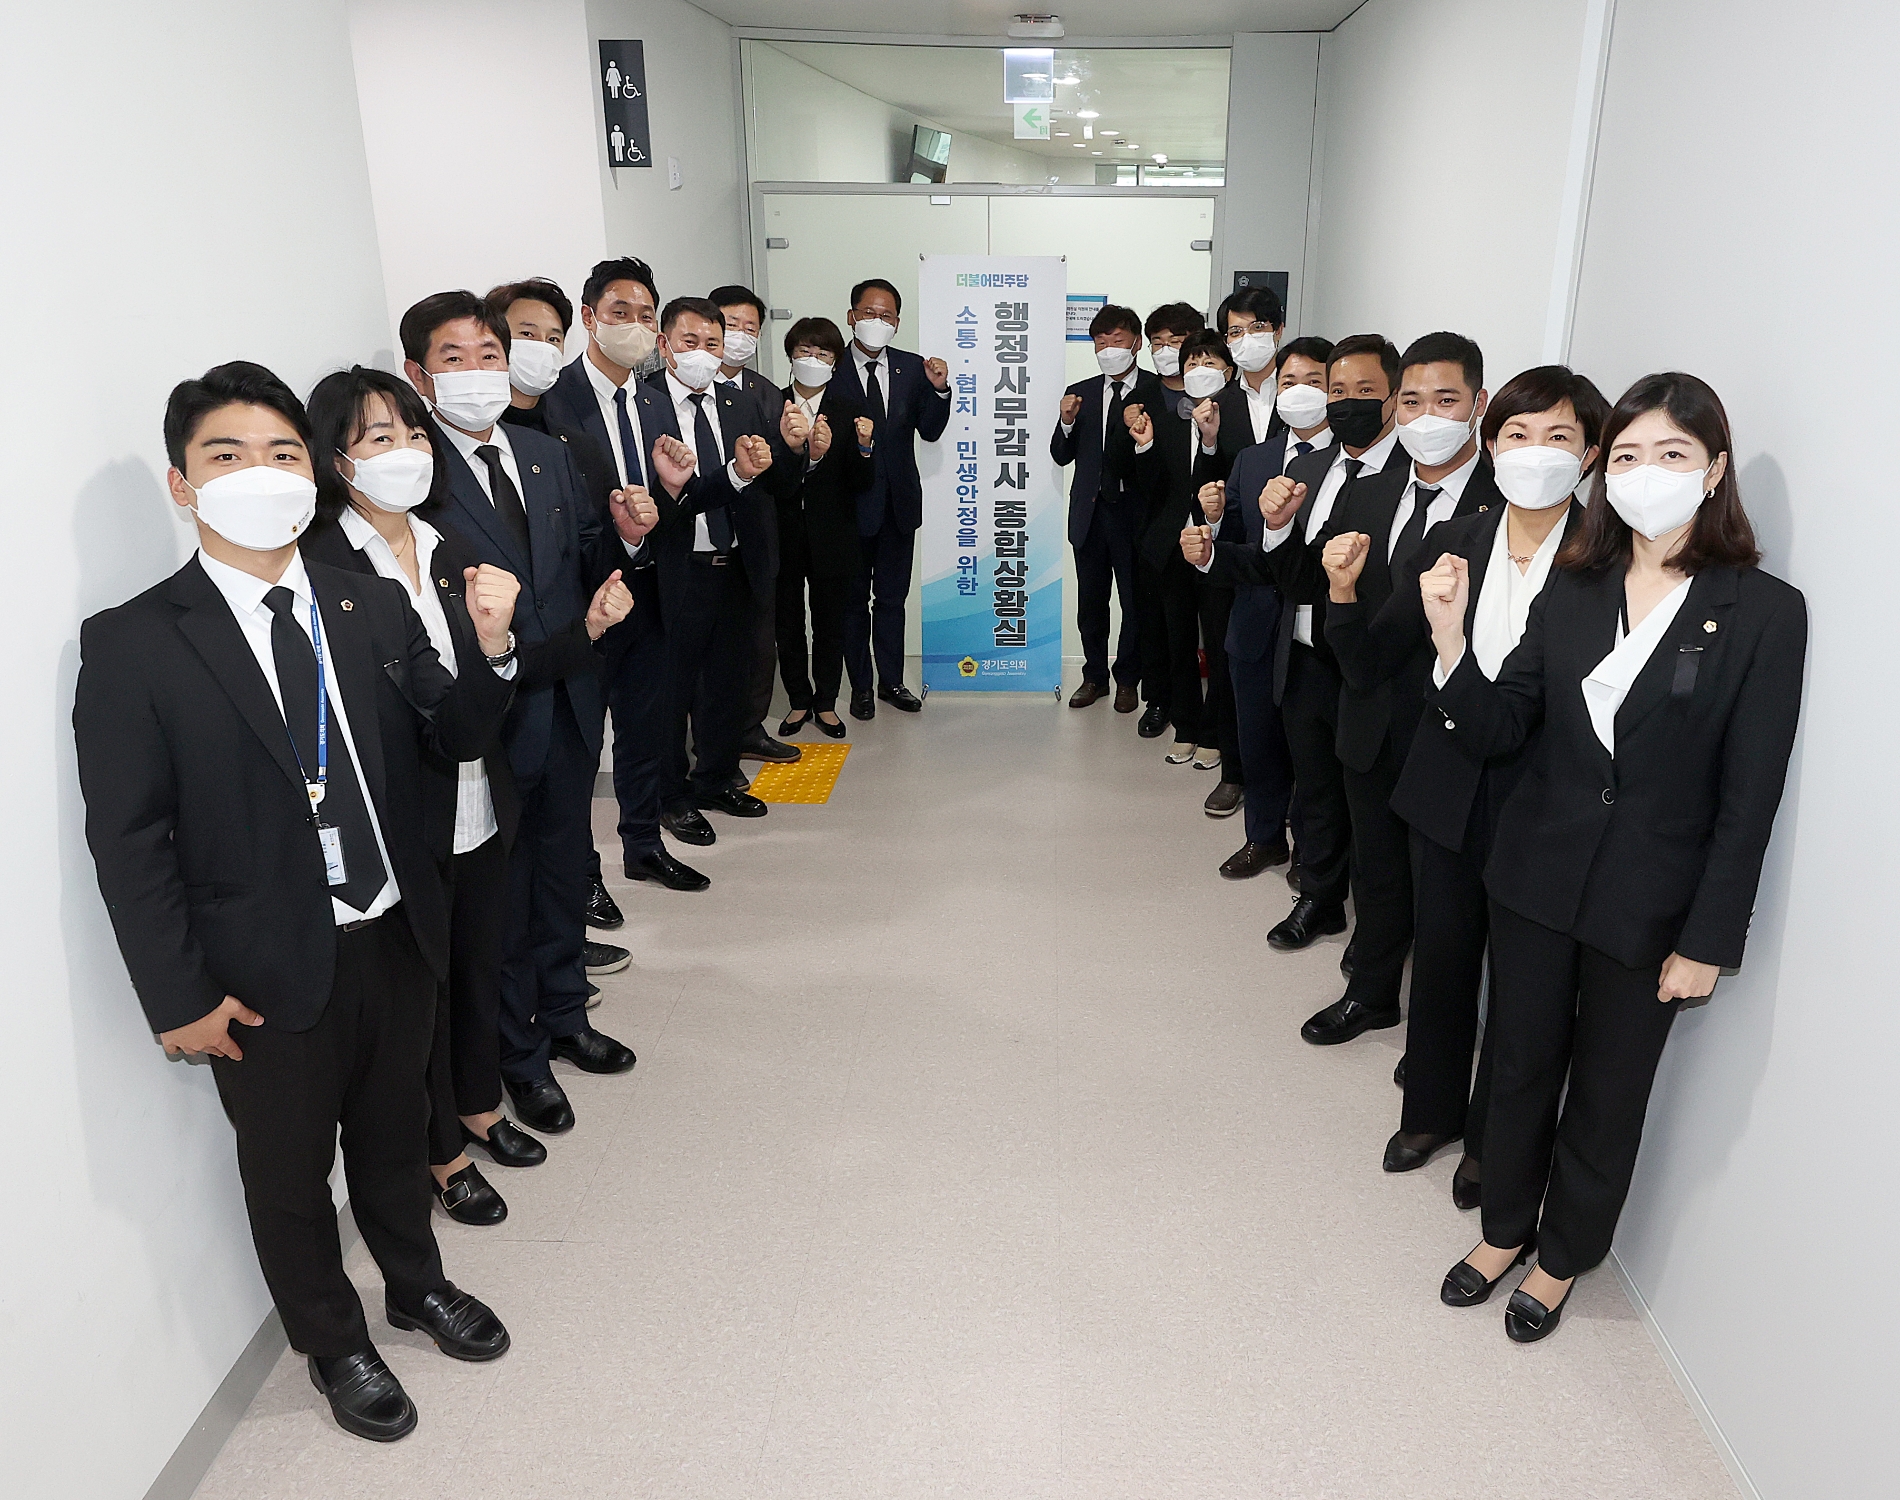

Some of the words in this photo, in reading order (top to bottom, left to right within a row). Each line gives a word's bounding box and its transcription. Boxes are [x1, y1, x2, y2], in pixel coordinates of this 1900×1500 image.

[956, 273, 1029, 288] 더불어민주당
[955, 305, 978, 349] 소통
[955, 373, 977, 416] 협치
[994, 301, 1030, 490] 행정사무감사
[956, 441, 978, 547] 민생안정을
[956, 555, 978, 596] 위한
[993, 500, 1030, 648] 종합상황실
[981, 659, 1027, 671] 경기도의회
